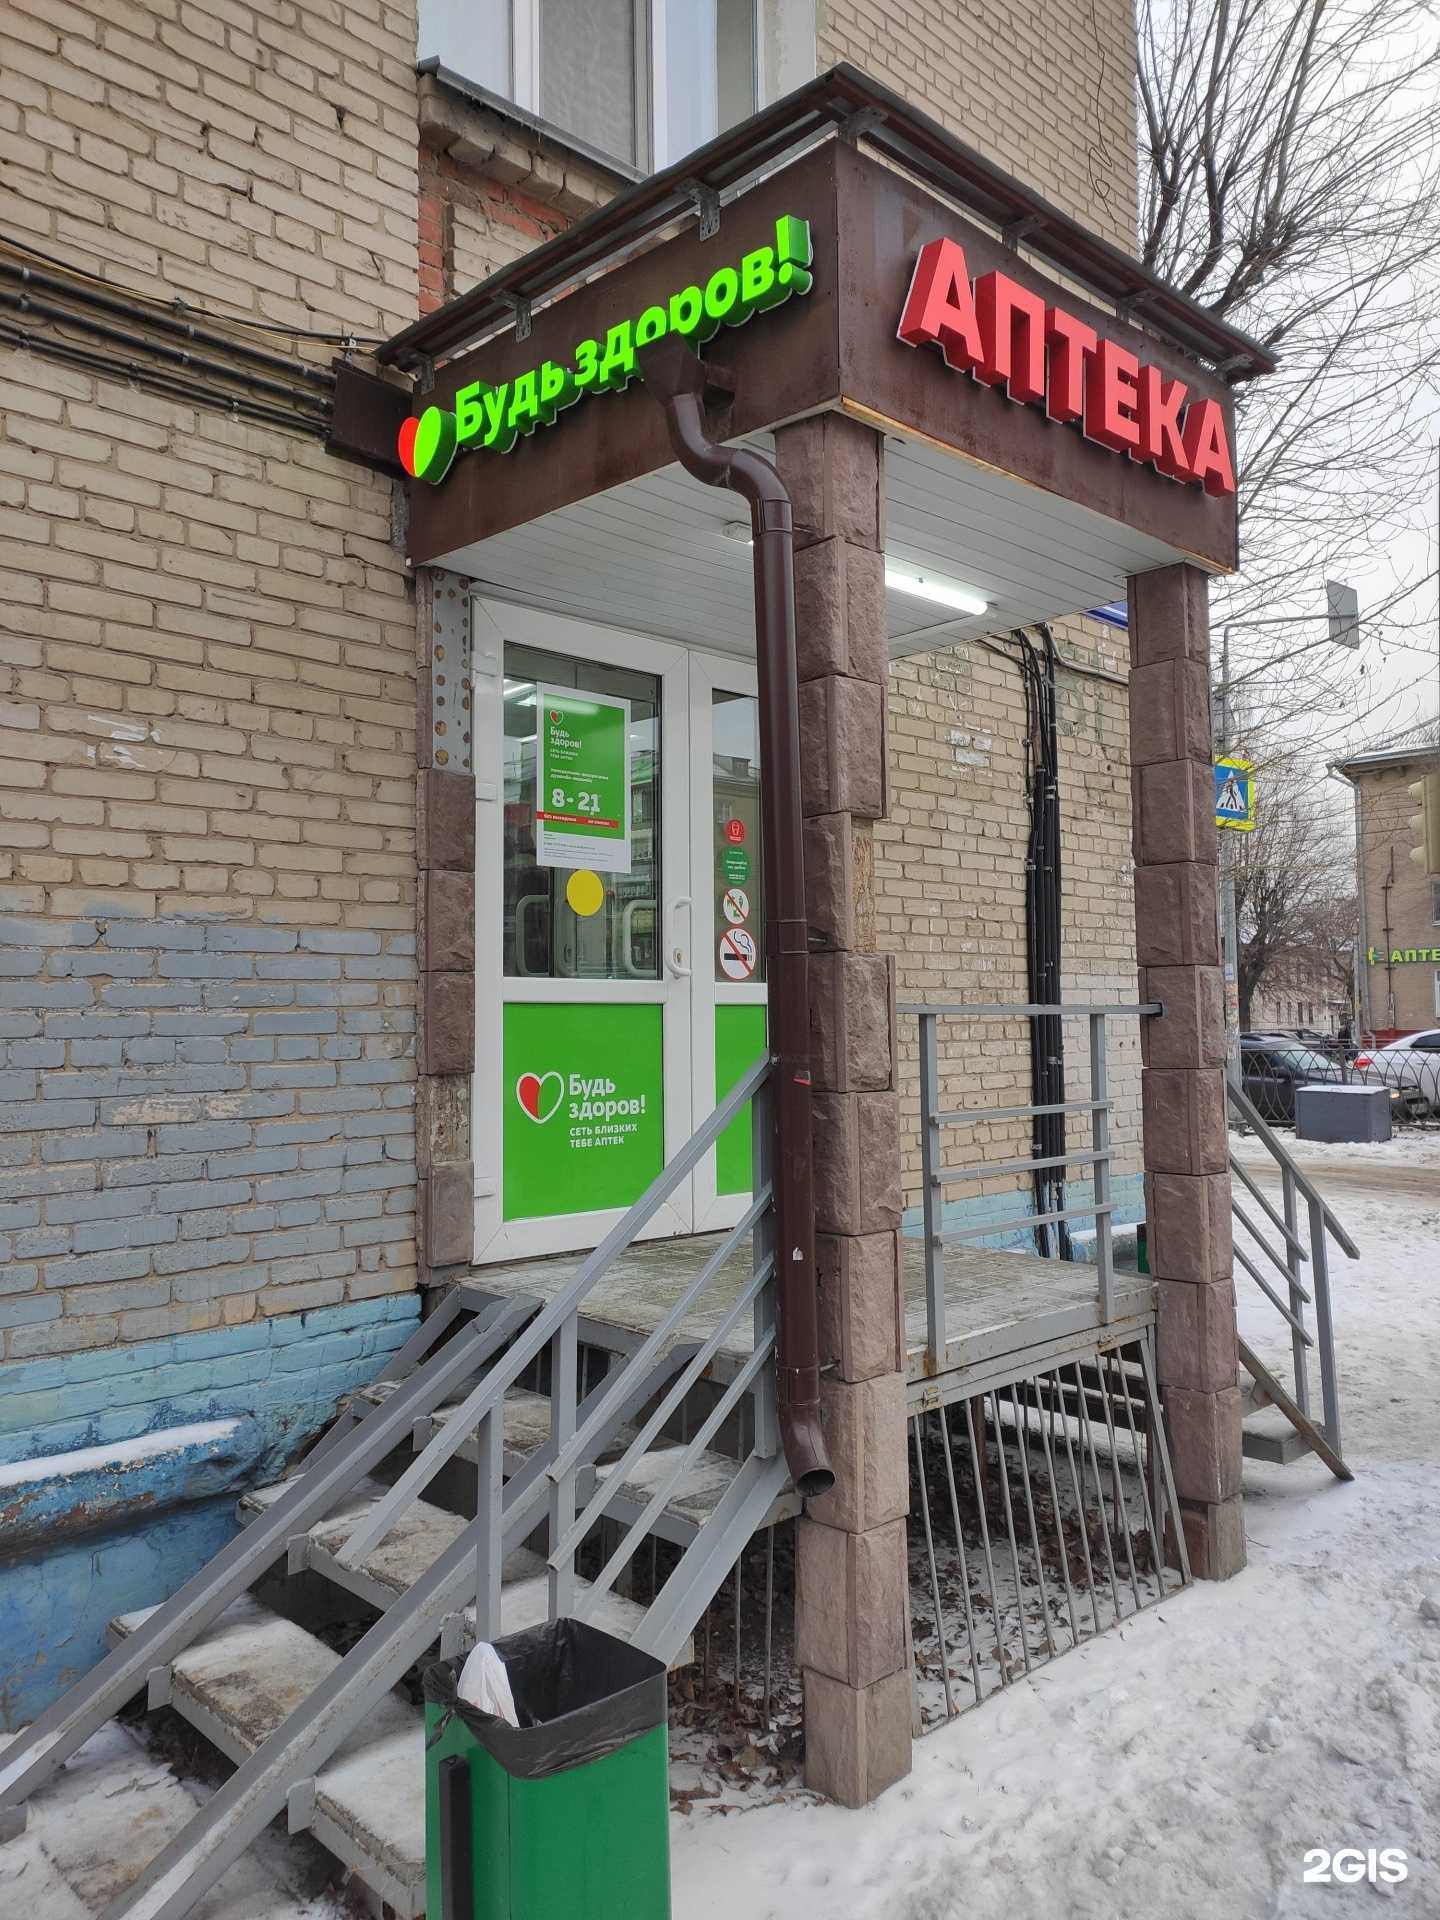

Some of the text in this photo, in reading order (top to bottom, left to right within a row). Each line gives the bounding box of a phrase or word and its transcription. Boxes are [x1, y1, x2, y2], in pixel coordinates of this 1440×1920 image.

[455, 214, 806, 448] Будь здоров!
[902, 237, 1236, 497] АПТЕКА
[550, 726, 570, 738] Будь
[569, 1073, 616, 1100] Будь
[568, 1094, 646, 1121] здоров!
[569, 1123, 638, 1137] СЕТЬ БЛИЗКИХ
[569, 1135, 625, 1149] ТЕБЕ АПТЕК
